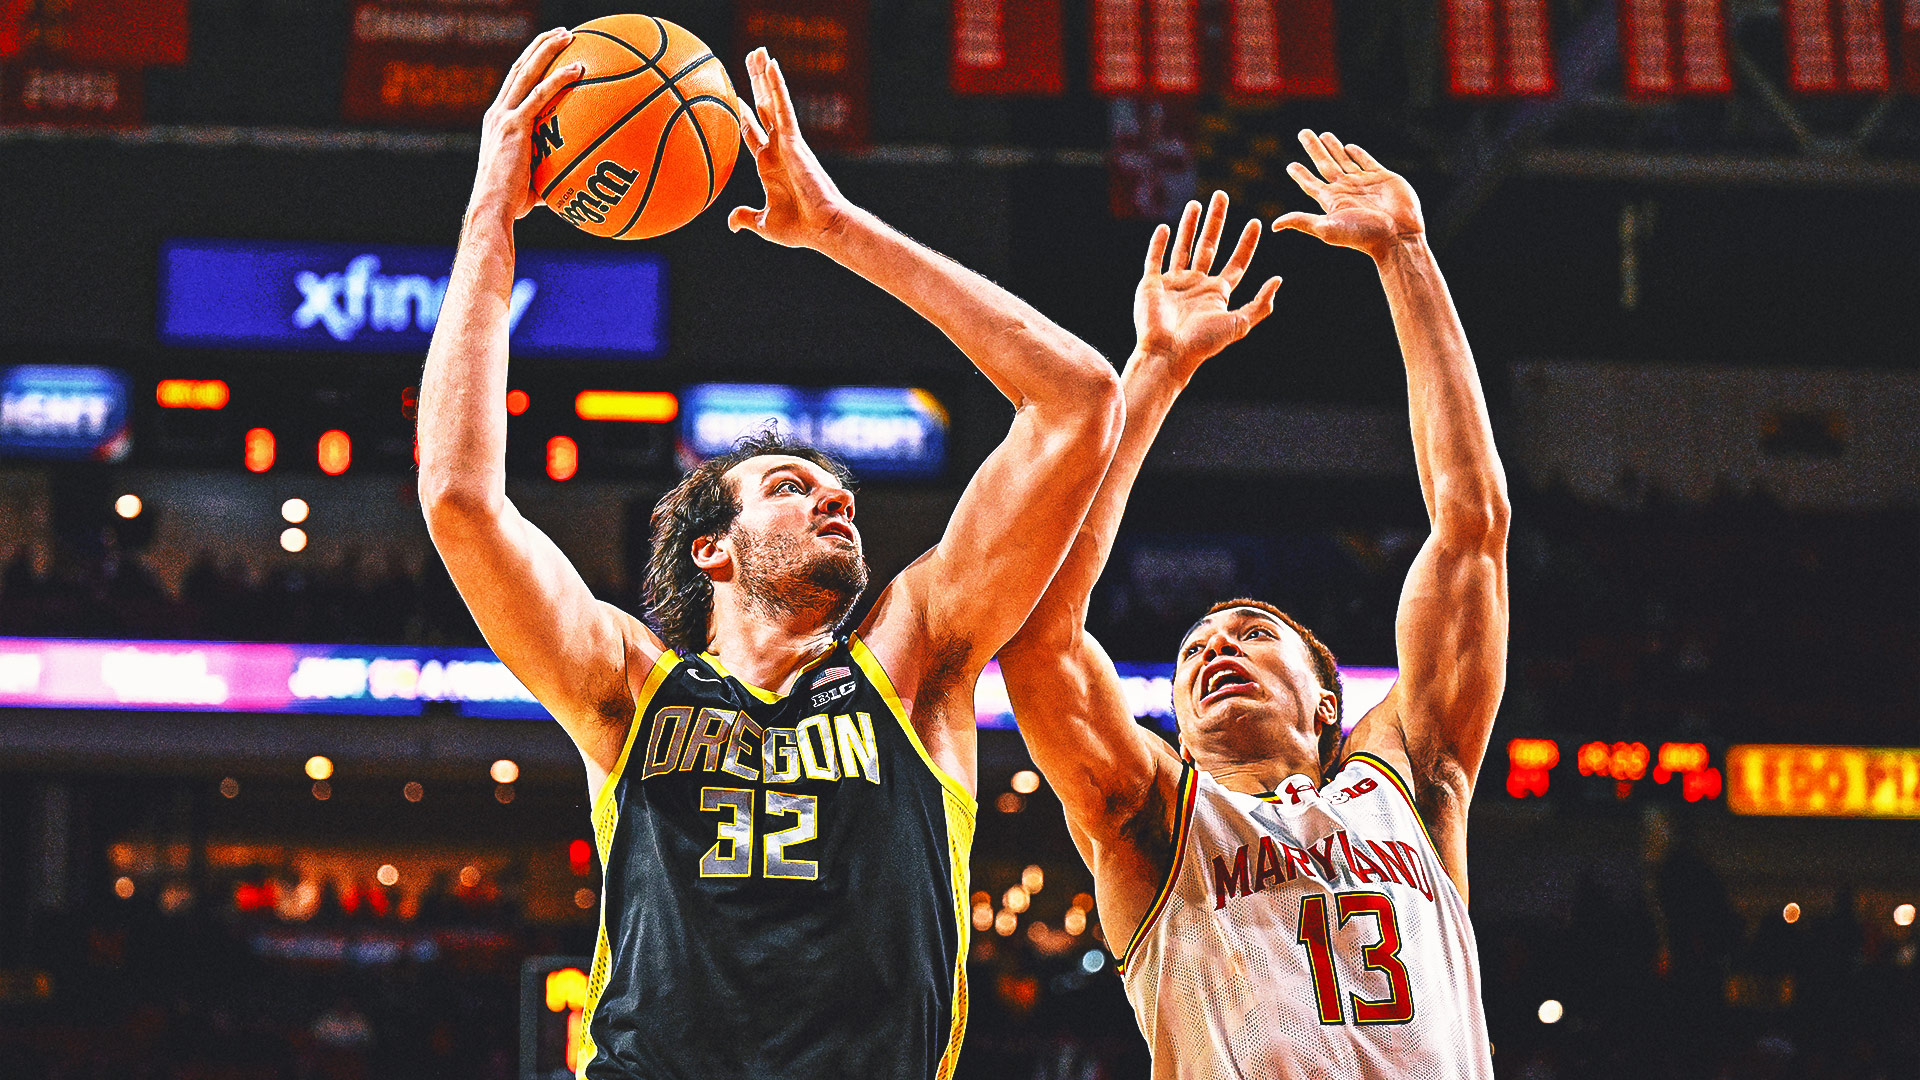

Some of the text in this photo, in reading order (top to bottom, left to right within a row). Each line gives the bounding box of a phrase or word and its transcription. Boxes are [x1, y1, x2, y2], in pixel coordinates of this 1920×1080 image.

[640, 706, 881, 785] OREGON
[699, 786, 819, 881] 32
[1212, 829, 1434, 912] MARYLAND
[1296, 890, 1415, 1027] 13
